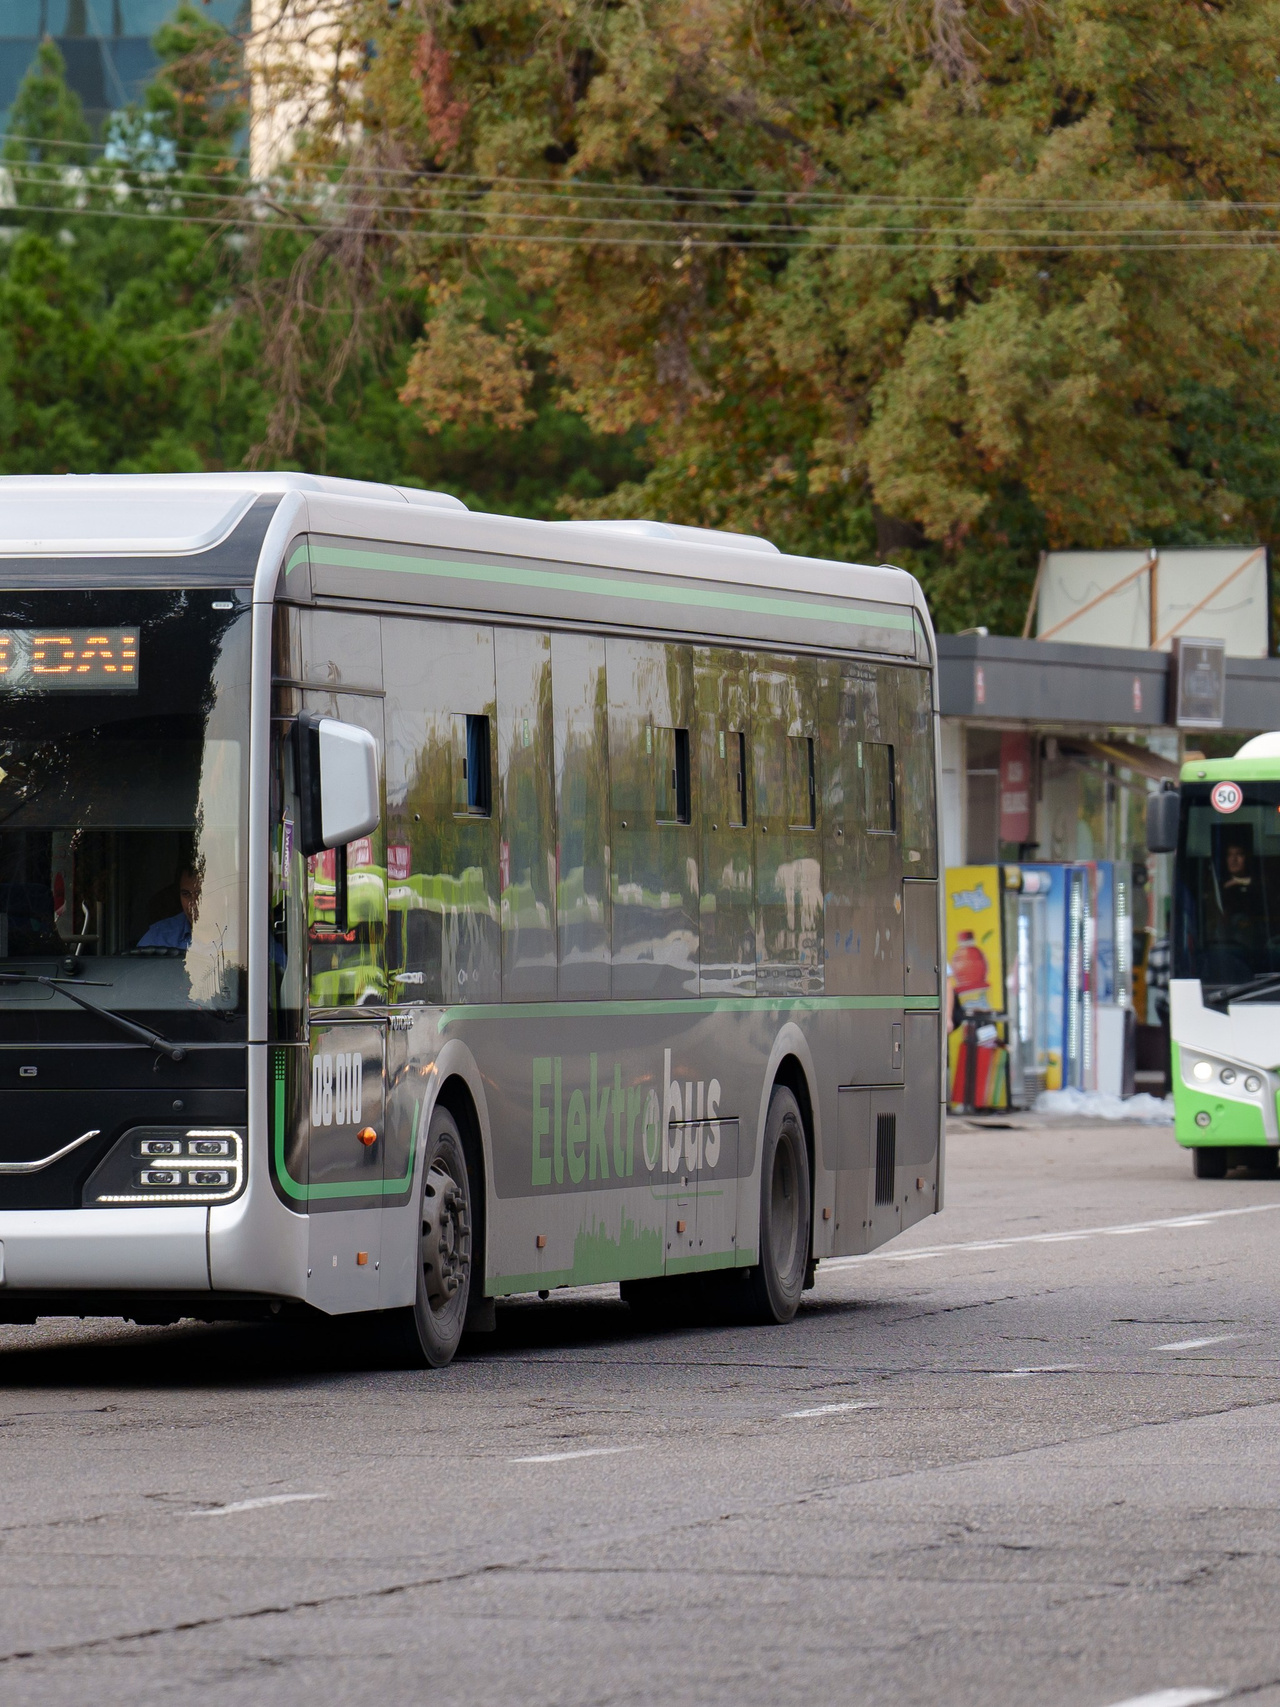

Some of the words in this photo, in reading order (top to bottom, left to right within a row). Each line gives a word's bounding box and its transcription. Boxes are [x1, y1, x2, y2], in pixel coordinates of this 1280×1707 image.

[1218, 790, 1236, 804] 50
[312, 1054, 333, 1127] 08
[336, 1052, 362, 1126] 010
[531, 1048, 721, 1186] Elektrobus
